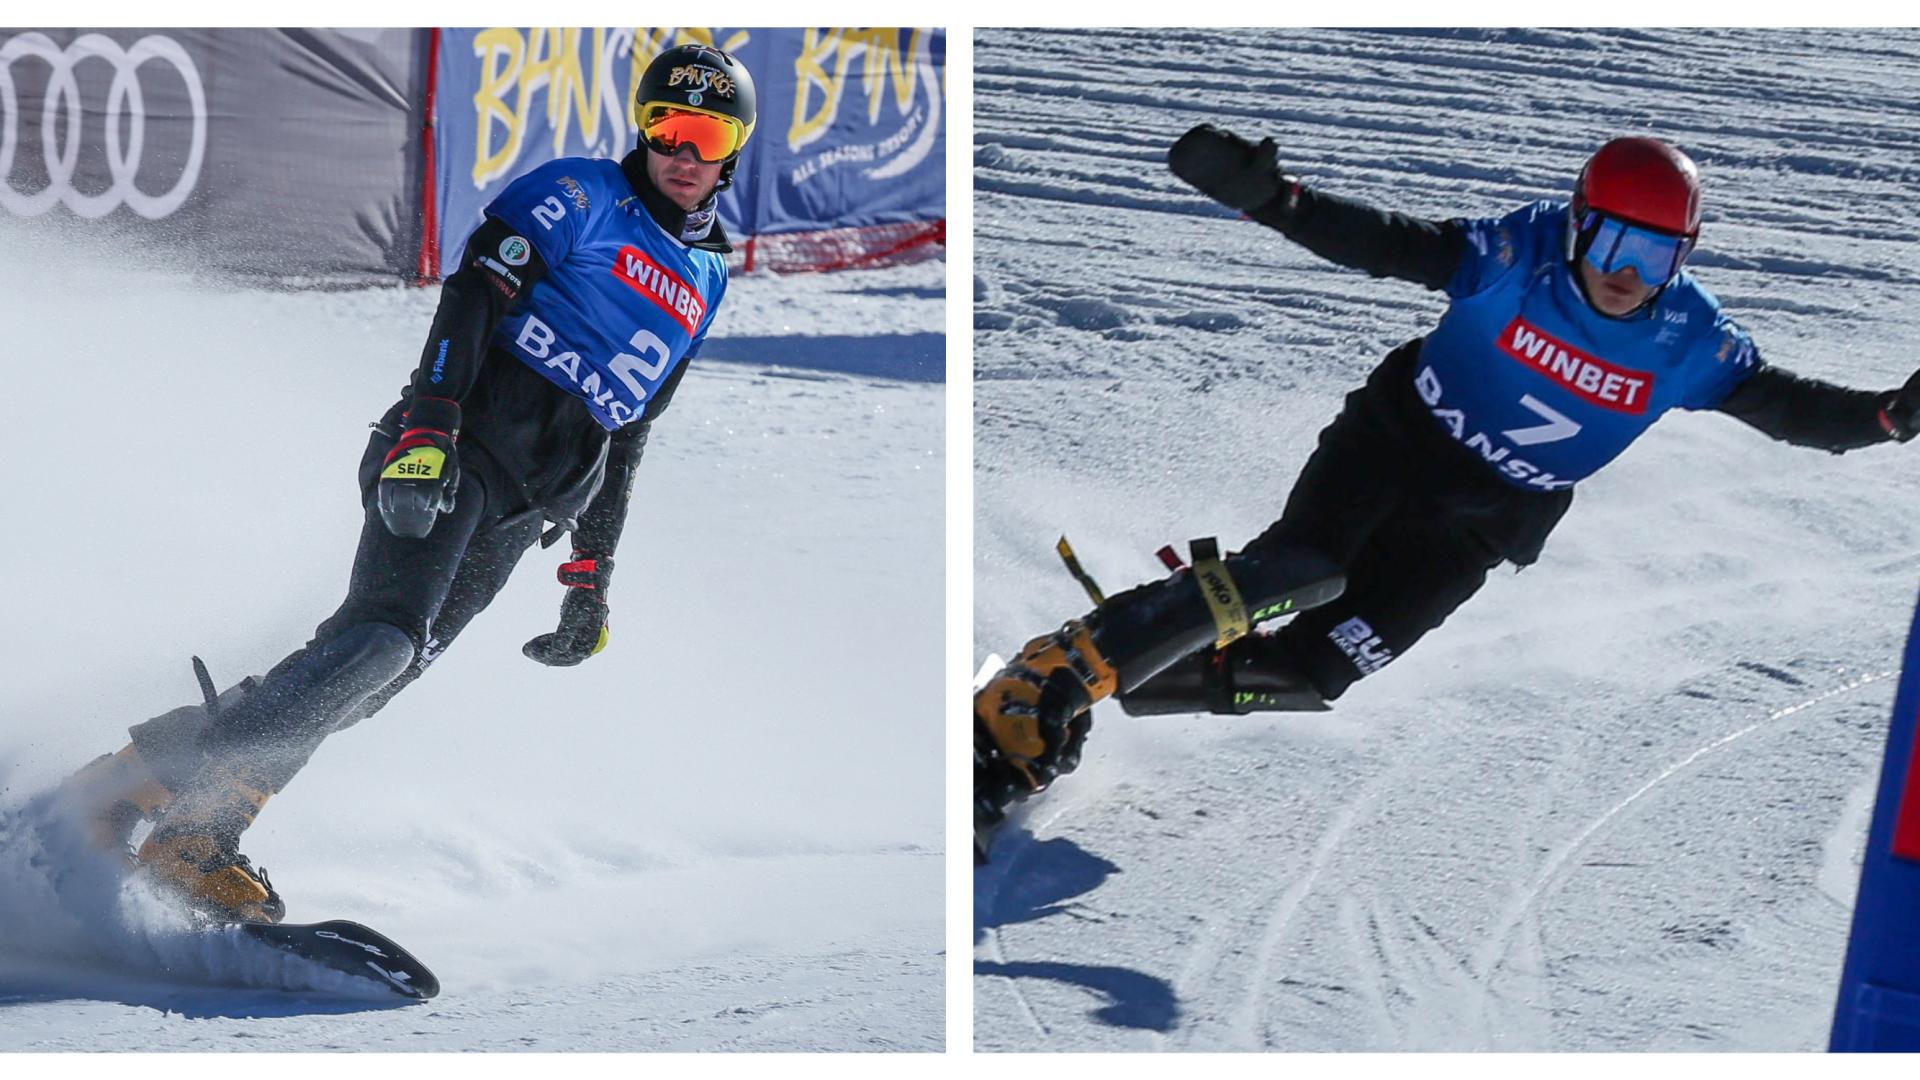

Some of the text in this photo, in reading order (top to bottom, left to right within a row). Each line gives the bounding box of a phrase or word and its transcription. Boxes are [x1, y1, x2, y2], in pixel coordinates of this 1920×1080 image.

[472, 27, 715, 190] BANS
[668, 65, 736, 98] BANSKO
[793, 106, 923, 186] ALL SEASONS RESORT
[531, 195, 566, 231] 2
[624, 253, 704, 329] WINBET
[433, 339, 450, 373] Fibank
[515, 315, 643, 427] BANS
[607, 329, 671, 401] 2
[1511, 325, 1644, 406] WINBET
[1501, 393, 1583, 446] 7
[1252, 598, 1293, 621] EKI
